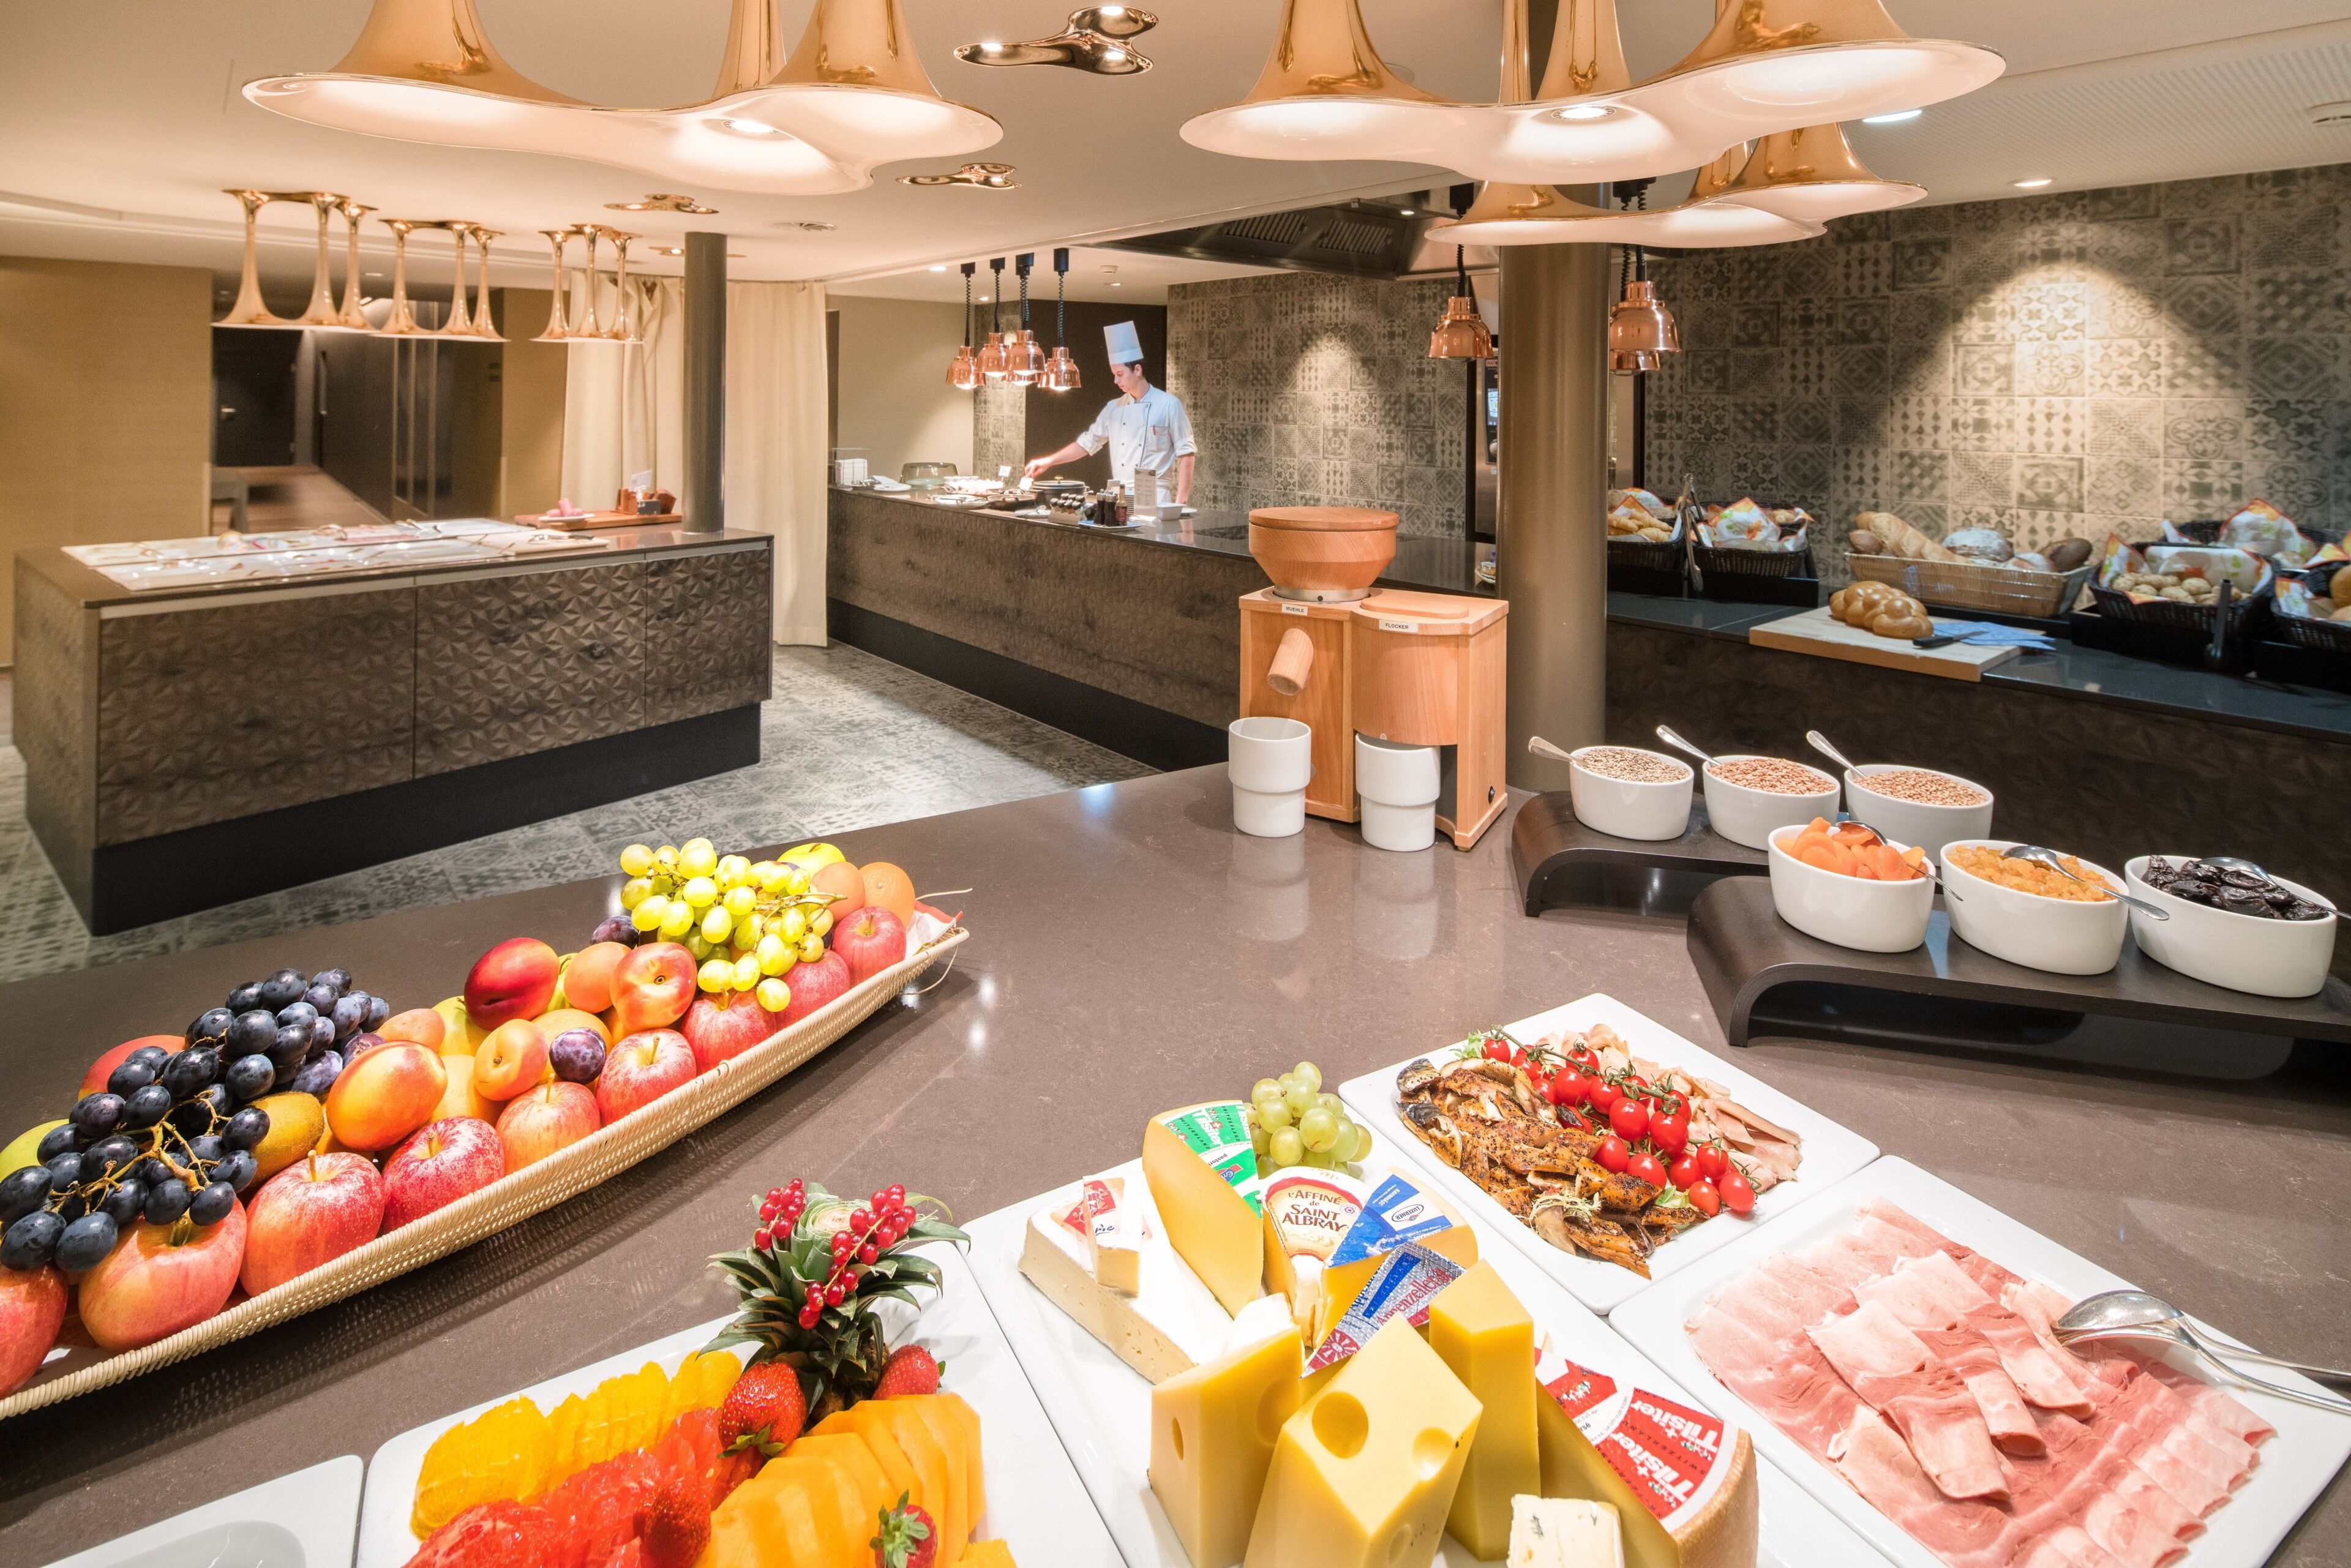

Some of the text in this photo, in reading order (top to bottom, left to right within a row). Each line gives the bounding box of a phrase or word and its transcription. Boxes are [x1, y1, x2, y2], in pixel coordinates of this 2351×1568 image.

[1179, 1117, 1210, 1150] SWITZERLAND
[1221, 1106, 1240, 1142] SWITZERLAND
[1282, 1212, 1348, 1232] ALBRAY
[1290, 1204, 1341, 1221] SAINT
[1395, 1206, 1420, 1220] LUZERNER
[1630, 1399, 1719, 1454] Tilsiter
[1623, 1420, 1706, 1475] SWITZERLAND
[1610, 1431, 1695, 1503] Tilsiter
